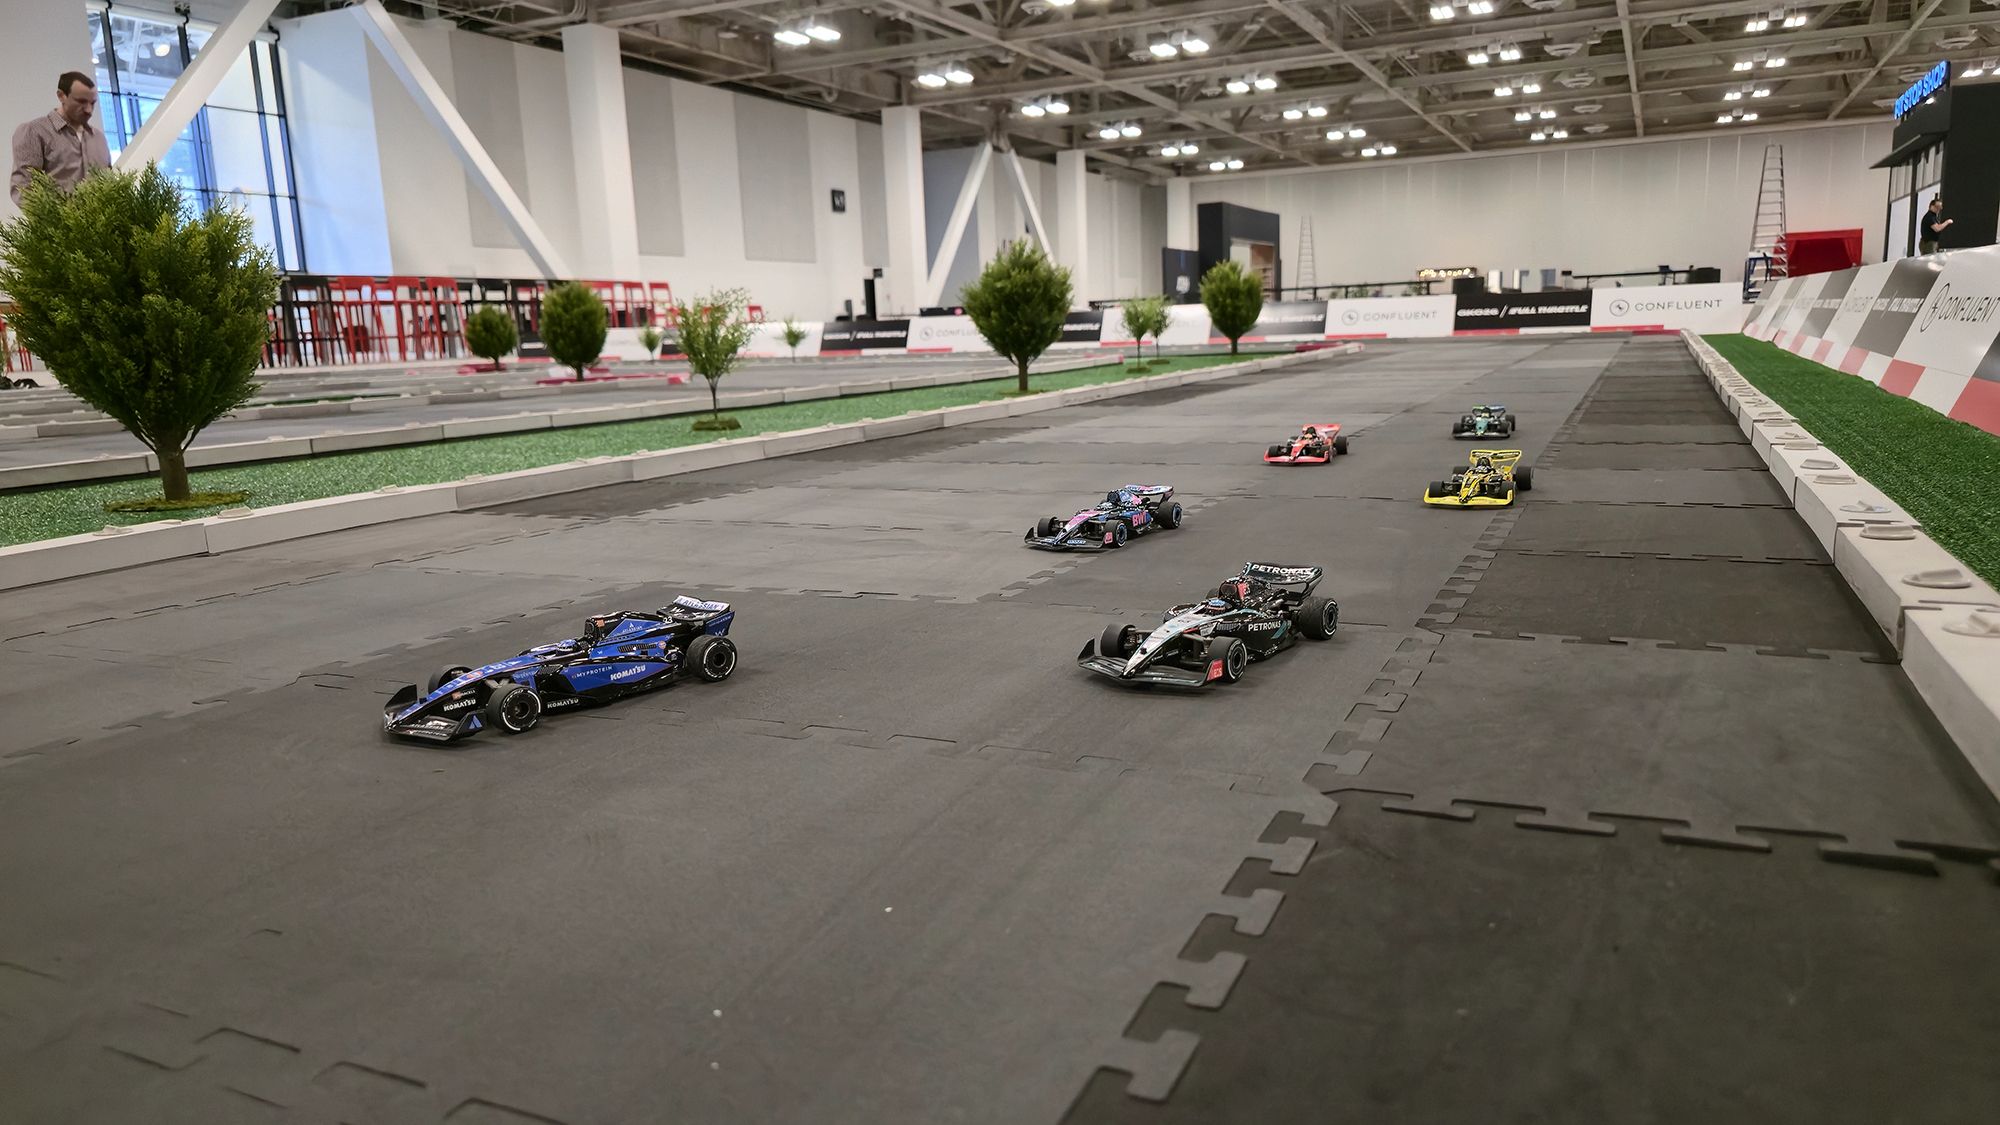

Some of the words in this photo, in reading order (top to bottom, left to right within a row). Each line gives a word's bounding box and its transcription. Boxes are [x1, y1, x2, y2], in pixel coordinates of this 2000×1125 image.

[1894, 94, 1906, 120] PIT
[1904, 79, 1923, 112] STOP
[1922, 60, 1947, 97] SHOP
[1634, 299, 1722, 312] CONFLUENT
[1938, 296, 2000, 323] CONFLUENT
[1362, 310, 1438, 322] CONFLUENT
[1132, 510, 1147, 527] BWT
[1251, 564, 1315, 576] PETRONAS
[1248, 620, 1281, 632] PETRONAS
[576, 666, 613, 678] MYPROTEIN
[610, 664, 647, 681] KOMATSU
[443, 699, 477, 712] KOMATSU
[547, 698, 580, 709] KOMATSU
